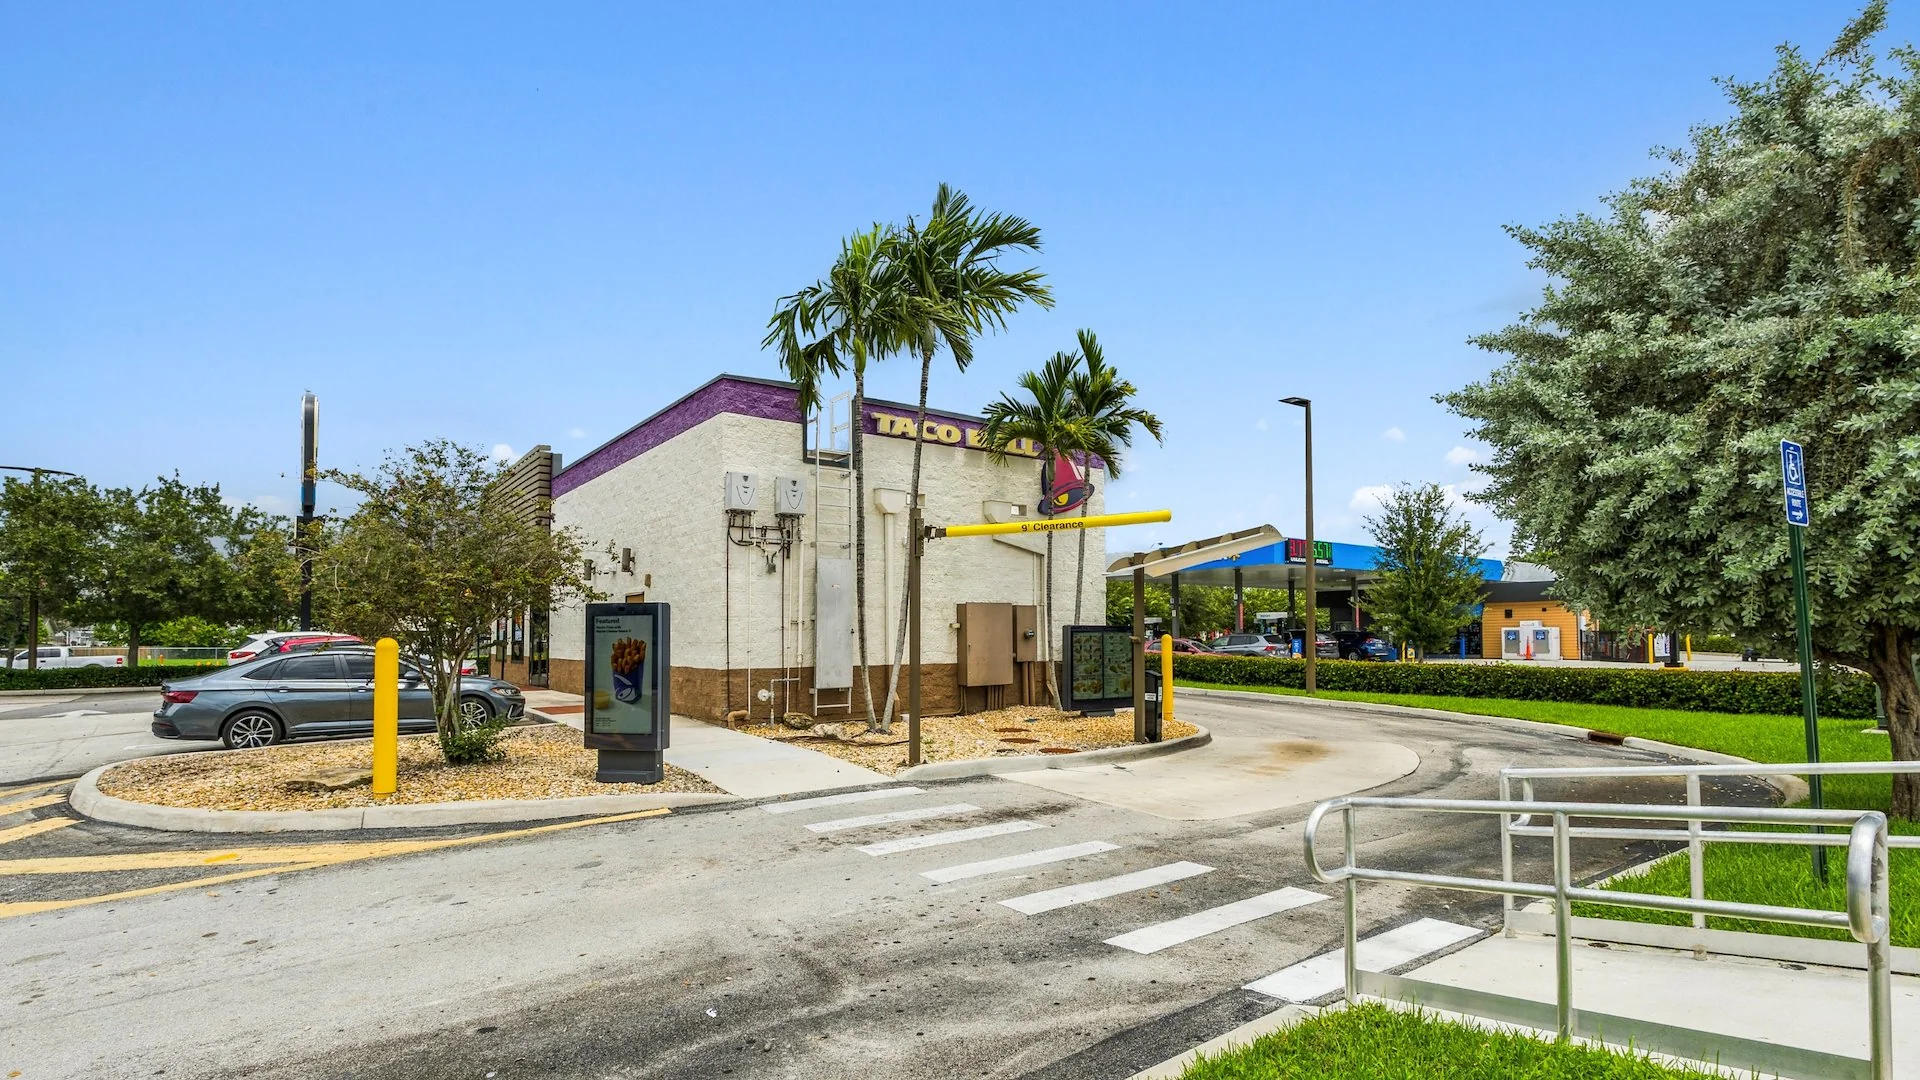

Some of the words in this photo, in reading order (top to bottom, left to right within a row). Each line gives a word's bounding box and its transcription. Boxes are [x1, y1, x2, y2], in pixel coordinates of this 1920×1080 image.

[870, 412, 961, 443] TACO
[1021, 523, 1030, 532] 9'
[1033, 521, 1084, 531] Clearance
